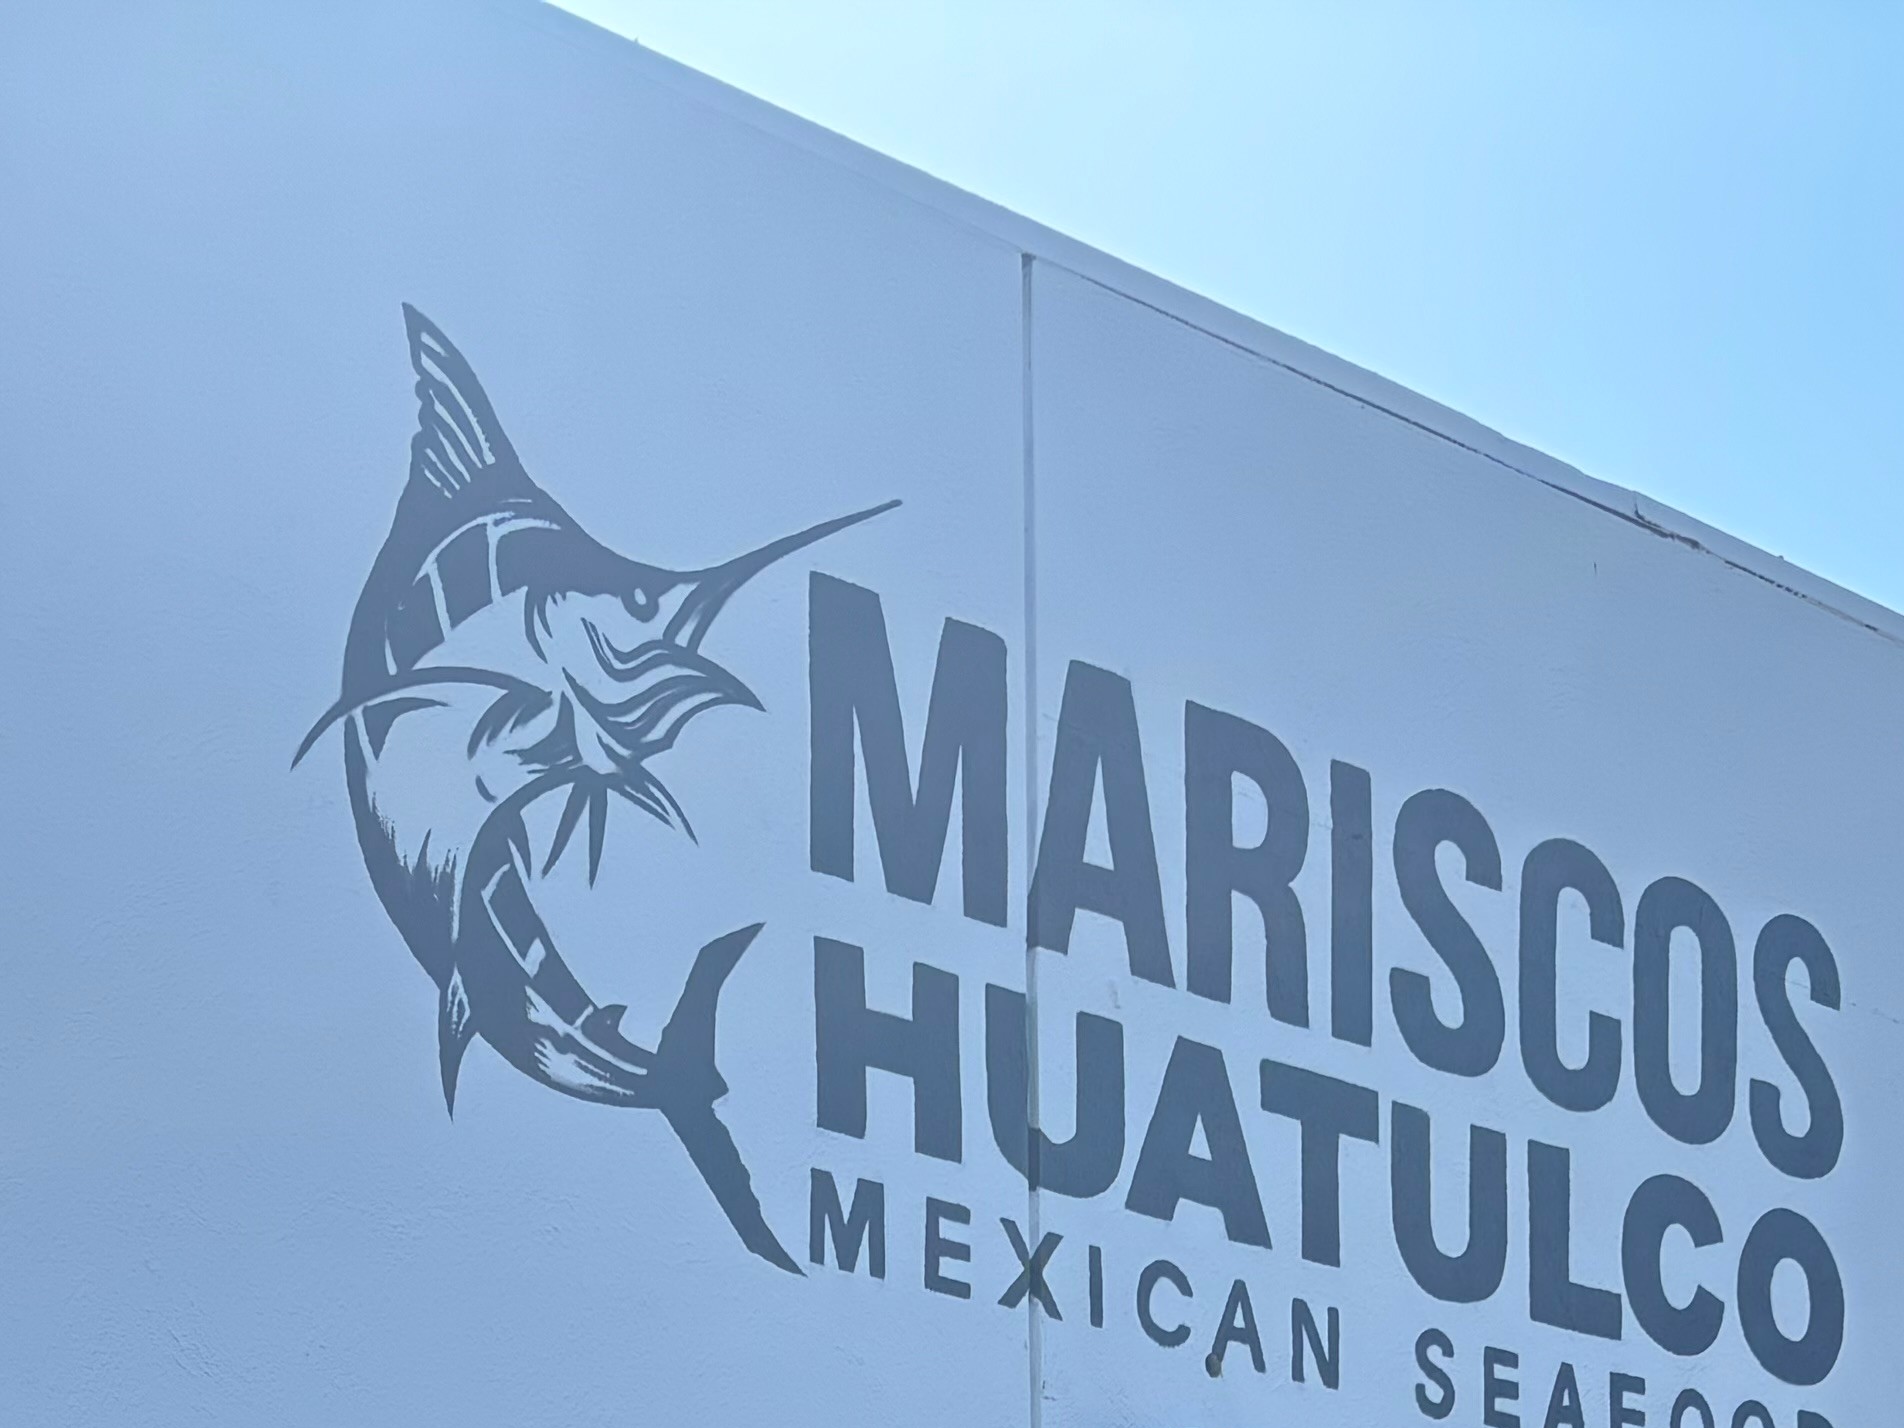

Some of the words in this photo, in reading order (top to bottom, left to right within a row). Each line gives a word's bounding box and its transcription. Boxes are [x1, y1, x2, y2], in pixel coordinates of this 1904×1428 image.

[808, 571, 1842, 1180] MARISCOS
[809, 1168, 1342, 1392] MEXICAN
[815, 935, 1844, 1387] HUATULCO
